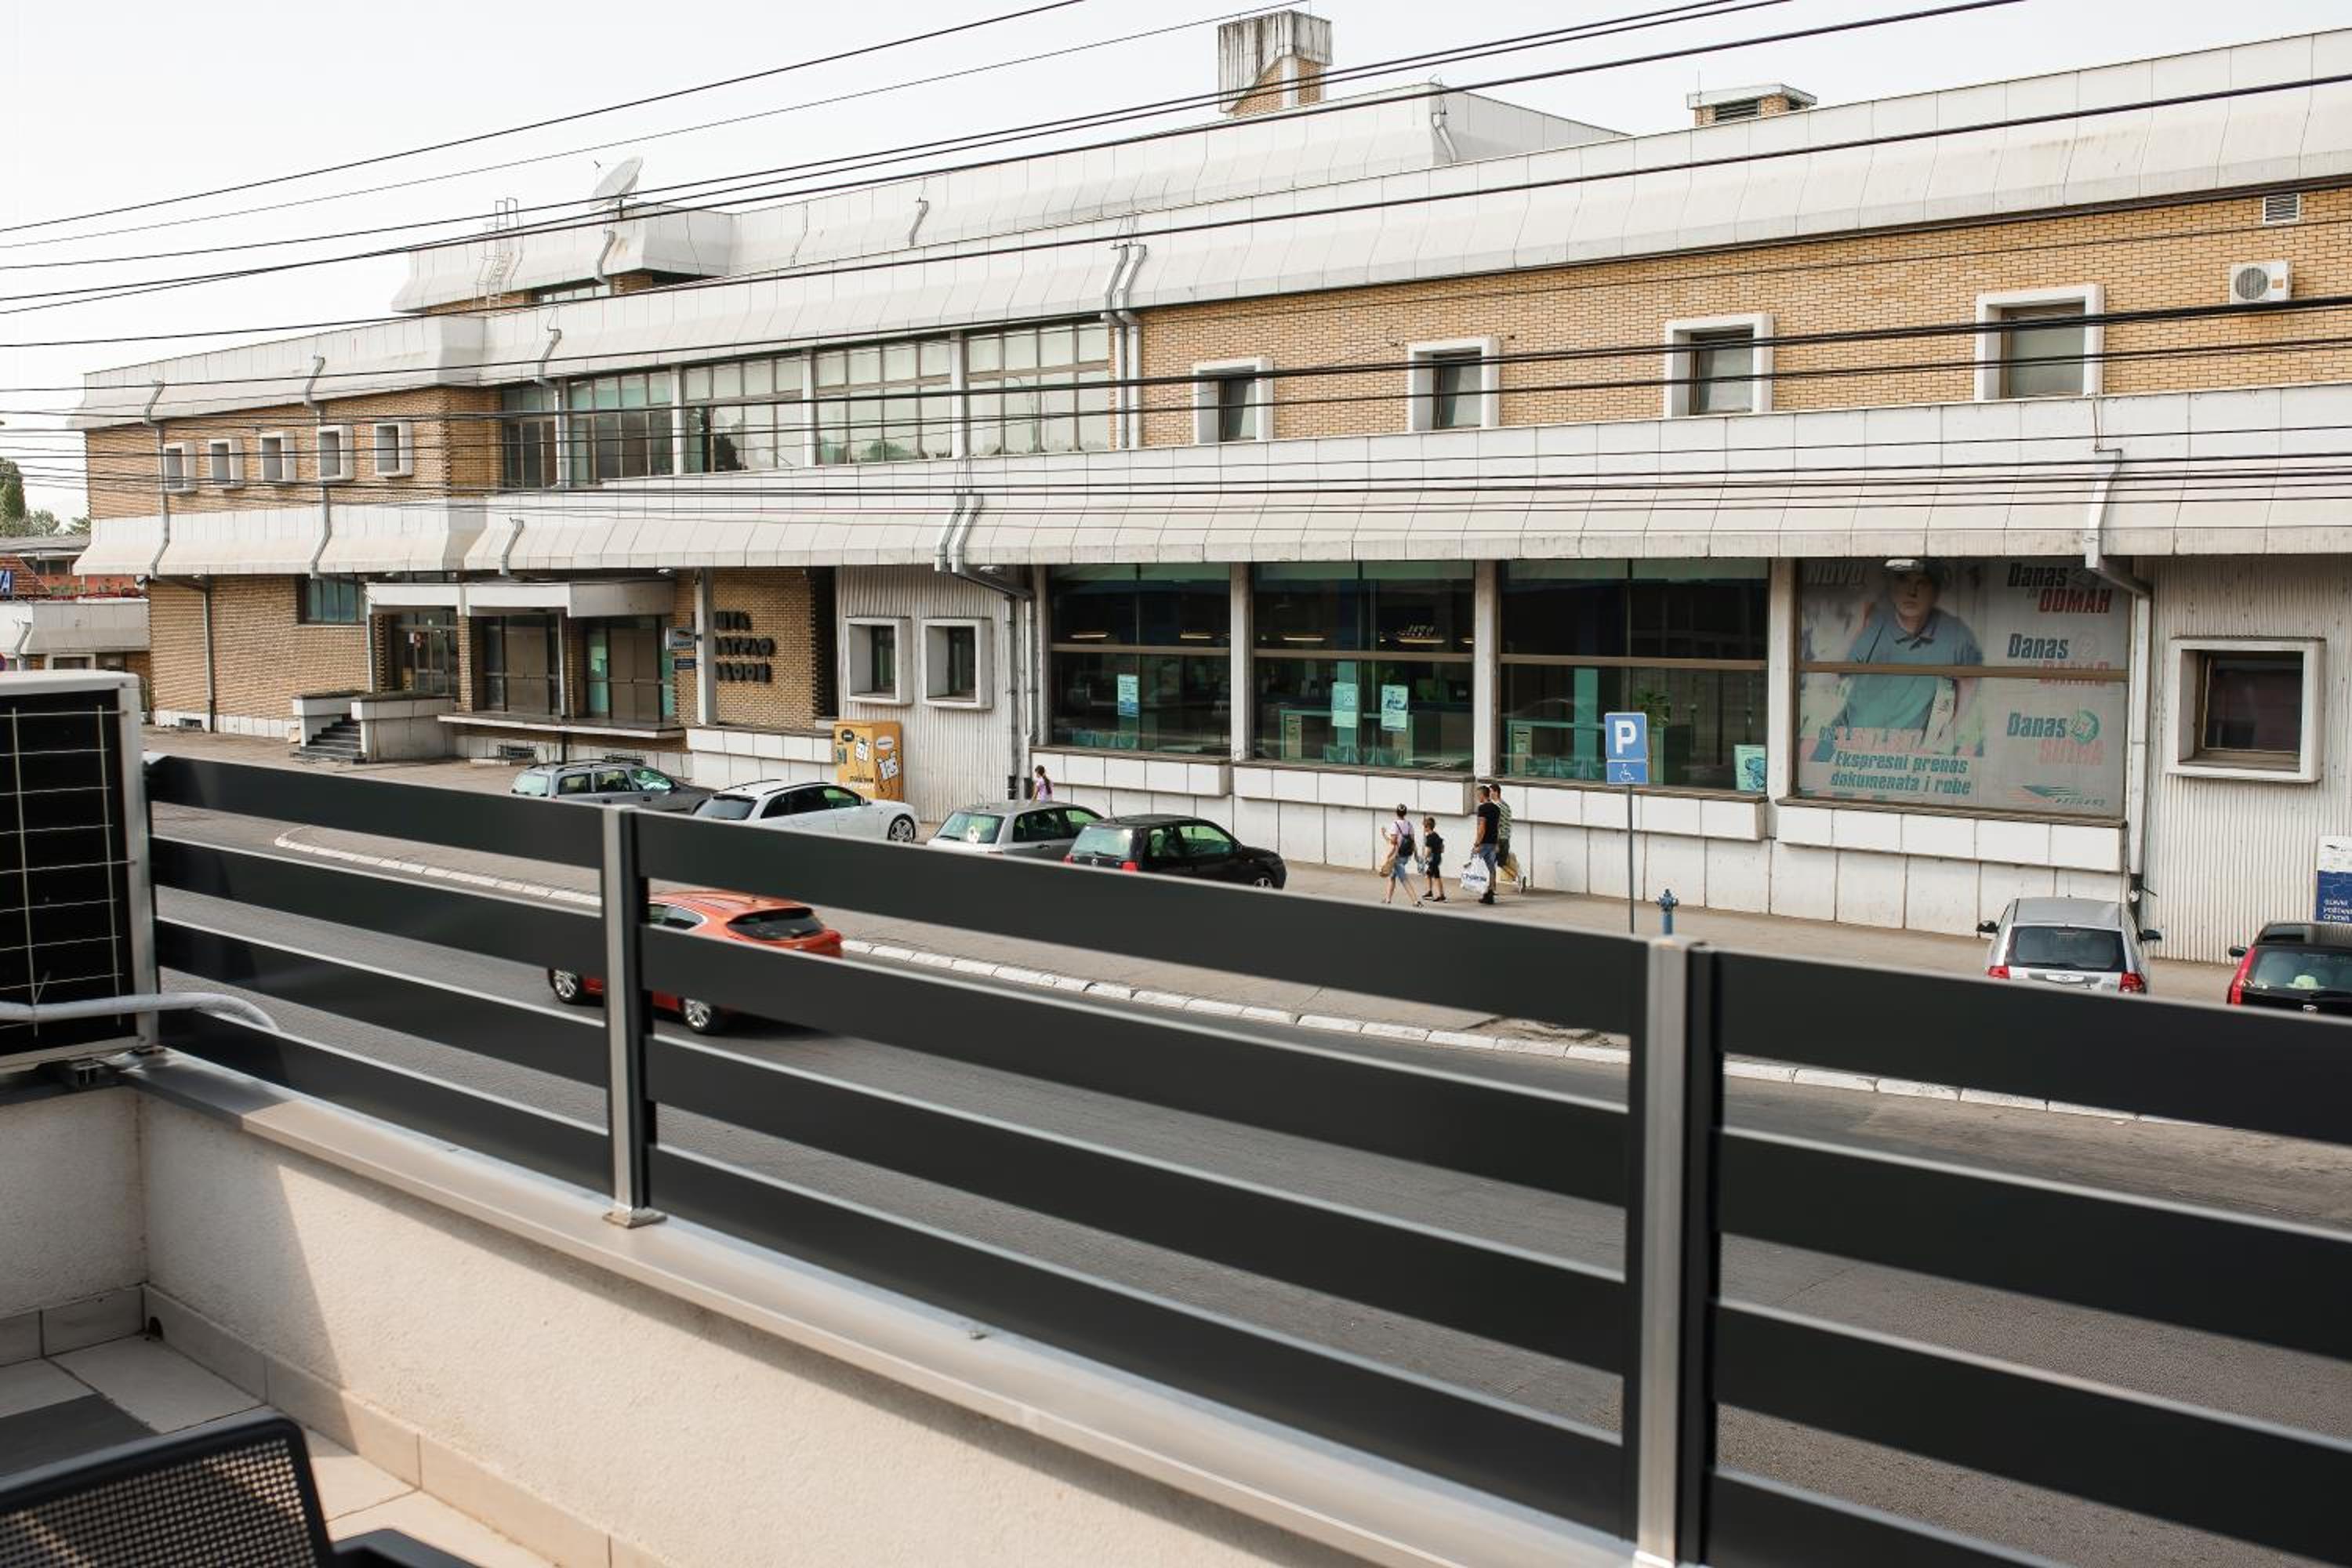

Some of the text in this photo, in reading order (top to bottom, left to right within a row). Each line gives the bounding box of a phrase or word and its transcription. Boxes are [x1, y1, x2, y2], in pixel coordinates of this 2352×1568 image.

[2007, 562, 2068, 587] Danas
[2007, 633, 2069, 659] Danas
[1615, 720, 1636, 754] P
[2007, 712, 2067, 739] Danas
